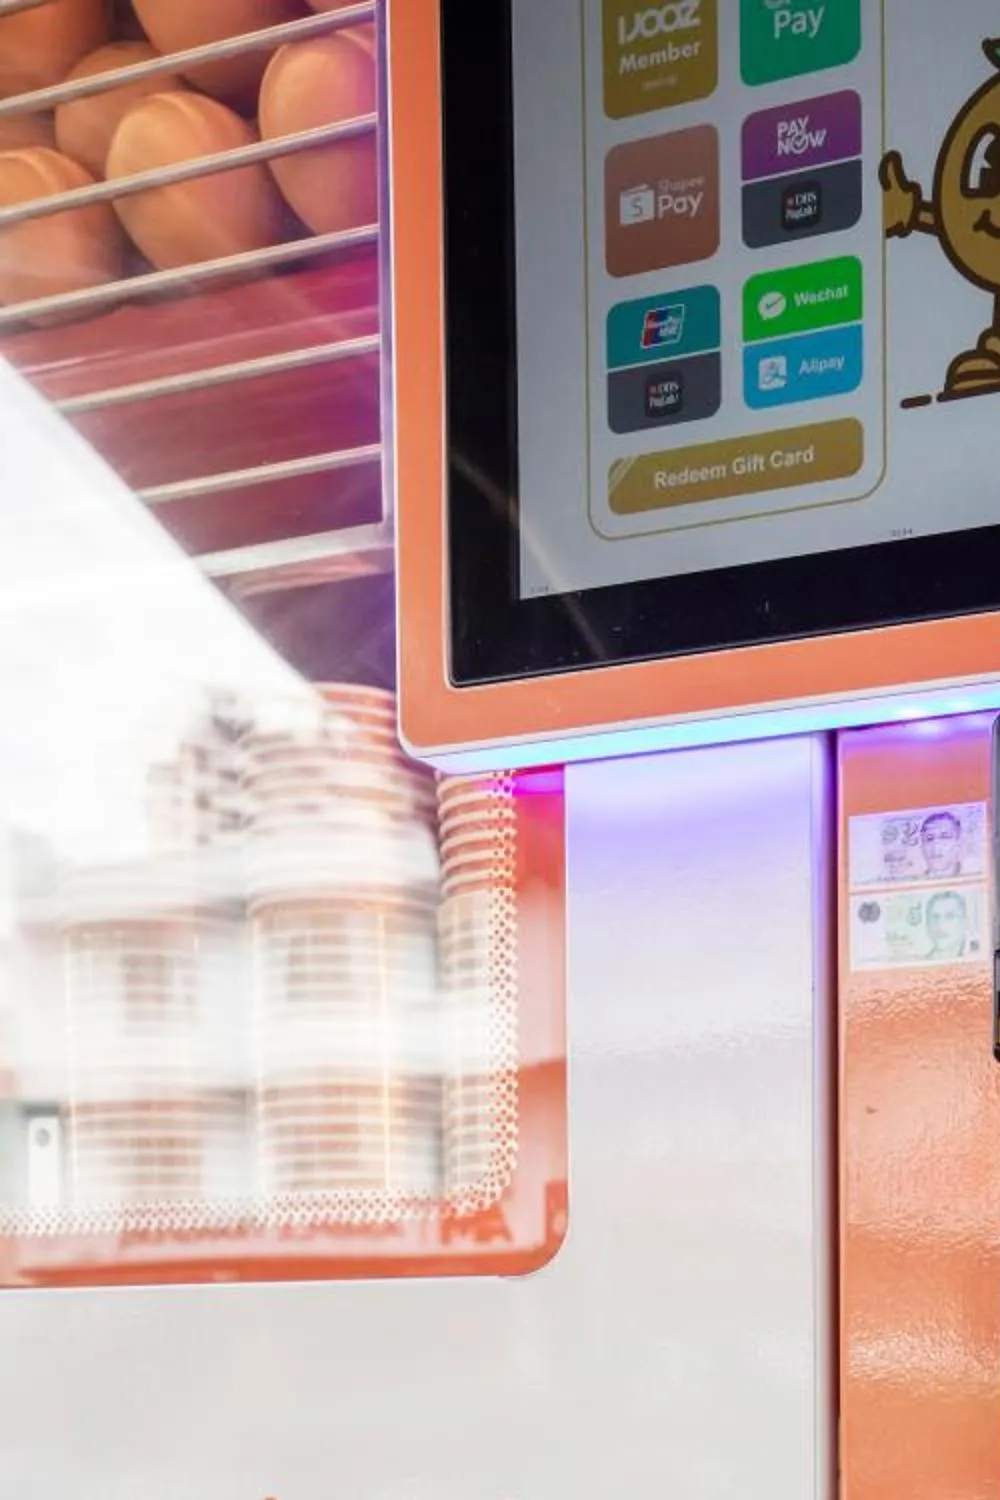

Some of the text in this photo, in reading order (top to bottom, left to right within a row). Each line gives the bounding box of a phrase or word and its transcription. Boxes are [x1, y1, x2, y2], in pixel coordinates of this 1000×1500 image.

[774, 7, 824, 39] Pay
[619, 42, 701, 74] Member
[778, 116, 809, 136] PAY
[778, 129, 827, 155] NOW
[658, 192, 703, 219] Pay
[794, 285, 848, 307] Wechat
[799, 355, 845, 375] Alipay
[655, 446, 814, 489] Redeem Gift Card
